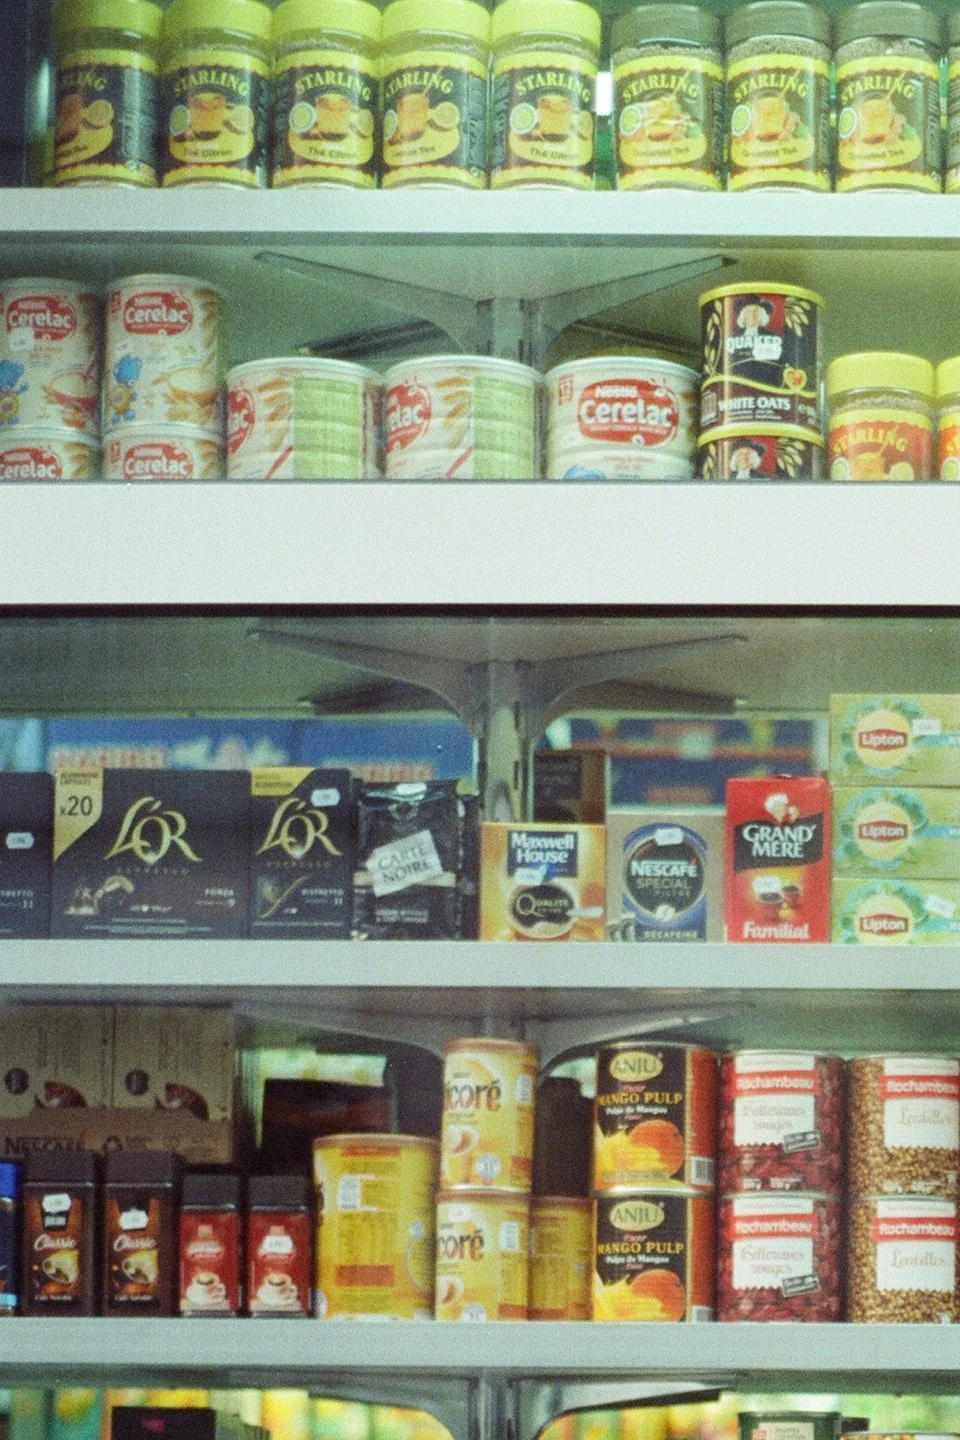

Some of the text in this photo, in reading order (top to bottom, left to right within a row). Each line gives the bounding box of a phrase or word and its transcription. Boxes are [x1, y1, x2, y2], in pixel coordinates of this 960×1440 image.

[295, 69, 371, 102] STARLING
[514, 72, 590, 103] STARLING
[622, 69, 699, 102] STARLING
[734, 71, 807, 102] STARLING
[841, 71, 913, 104] STARLING
[125, 304, 190, 325] Cerelac
[580, 399, 674, 428] Cerelac
[718, 397, 791, 411] WHITE OATS
[834, 427, 908, 454] STARLING
[125, 455, 188, 478] Cerelac
[861, 732, 906, 749] Lipton
[861, 824, 906, 840] Lipton
[510, 833, 575, 851] Maxwell
[516, 847, 568, 864] House
[743, 922, 810, 941] Familial
[861, 917, 908, 934] Lipton
[615, 1056, 660, 1076] ANJU
[644, 1091, 684, 1106] PULP
[614, 1205, 661, 1224] ANJU
[646, 1242, 684, 1255] PULP
